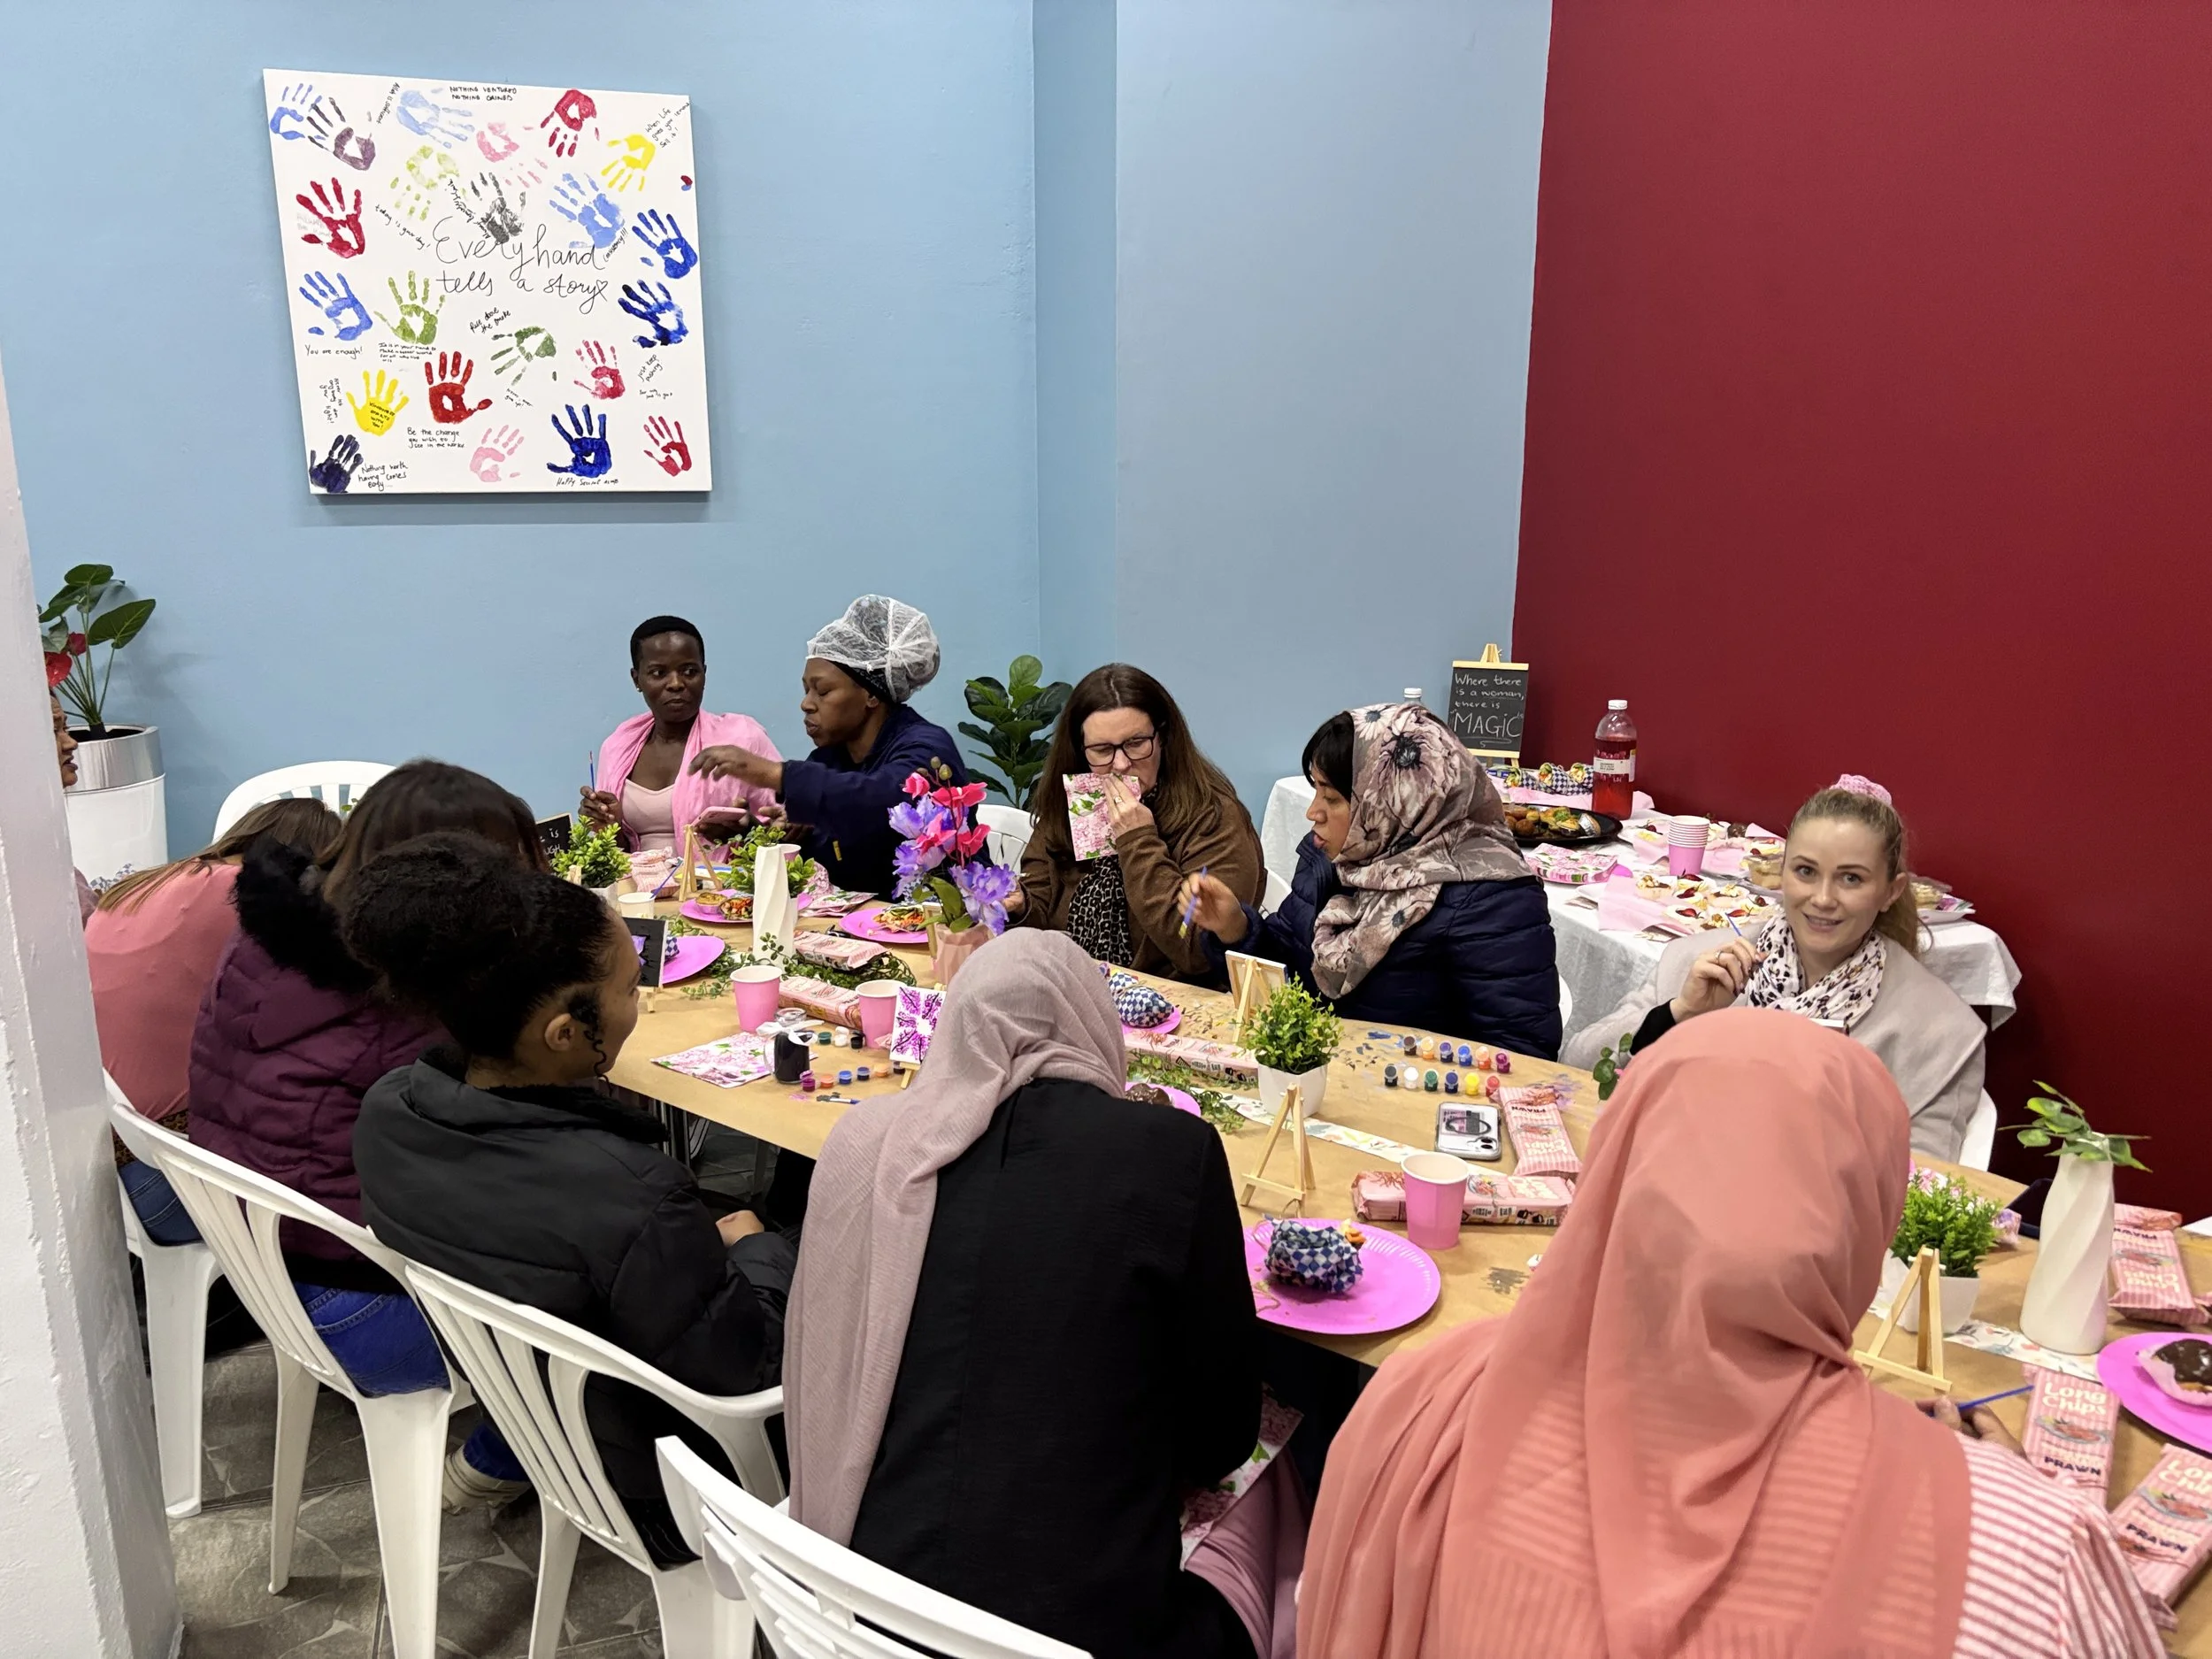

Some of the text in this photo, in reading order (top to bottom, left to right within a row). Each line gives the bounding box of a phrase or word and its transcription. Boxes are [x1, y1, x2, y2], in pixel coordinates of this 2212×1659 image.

[433, 216, 606, 281] Every hand
[435, 270, 603, 315] tells a story
[304, 344, 319, 357] You
[407, 426, 417, 435] Be
[435, 430, 460, 442] change
[1455, 673, 1522, 687] Where there
[1455, 687, 1465, 695] is
[1481, 690, 1525, 701] woman,
[549, 828, 559, 839] is
[2044, 1381, 2107, 1405] Long
[2041, 1395, 2107, 1416] Chips
[2044, 1455, 2101, 1476] PRAWN
[2125, 1523, 2188, 1553] PRAWN
